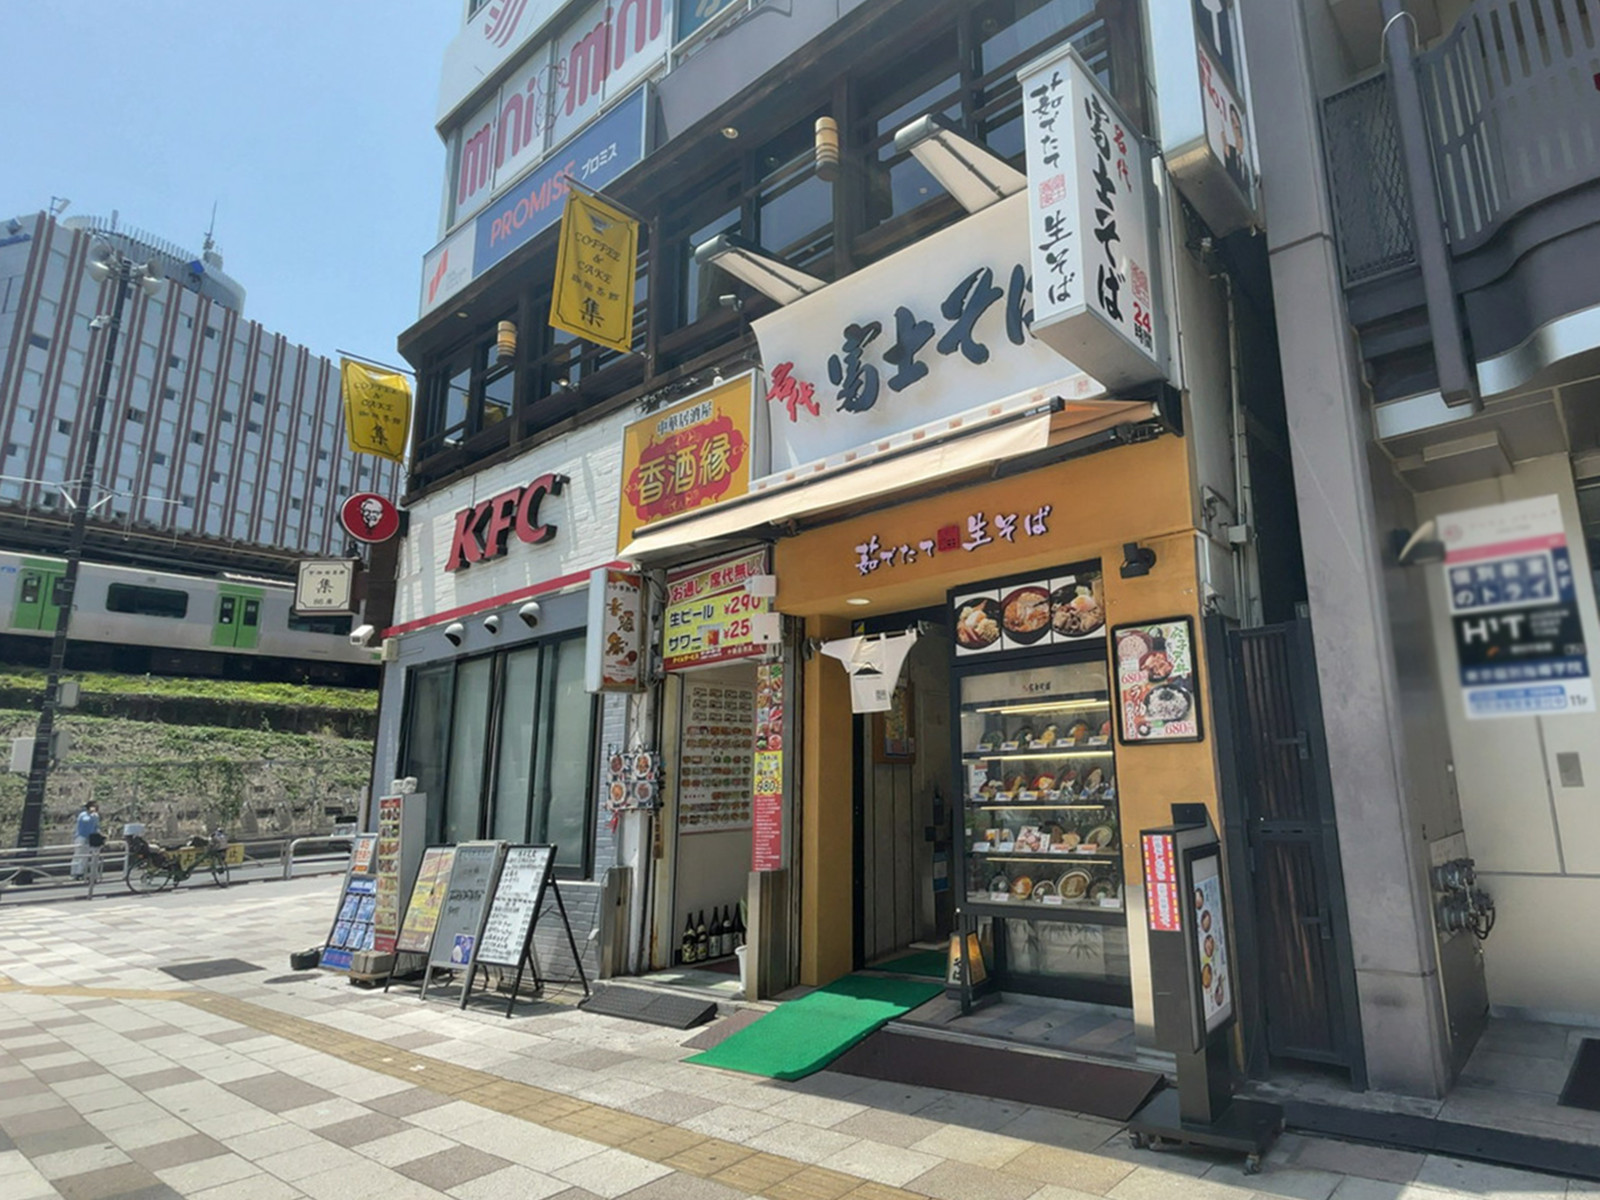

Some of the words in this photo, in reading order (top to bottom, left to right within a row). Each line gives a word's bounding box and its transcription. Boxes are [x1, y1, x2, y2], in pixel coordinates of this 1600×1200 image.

[581, 142, 618, 180] プロミス
[490, 160, 576, 248] PROMISE
[574, 231, 621, 262] COFFEE
[593, 254, 604, 264] &
[1038, 209, 1075, 305] 生そば
[577, 260, 612, 285] CAKE
[579, 296, 605, 328] 集
[1133, 301, 1152, 333] 24
[445, 473, 570, 573] KFC
[962, 505, 1051, 551] 生そば
[669, 604, 714, 627] 生ビール
[723, 594, 761, 615] ¥290
[668, 634, 702, 652] サワー
[723, 618, 753, 640] ¥25
